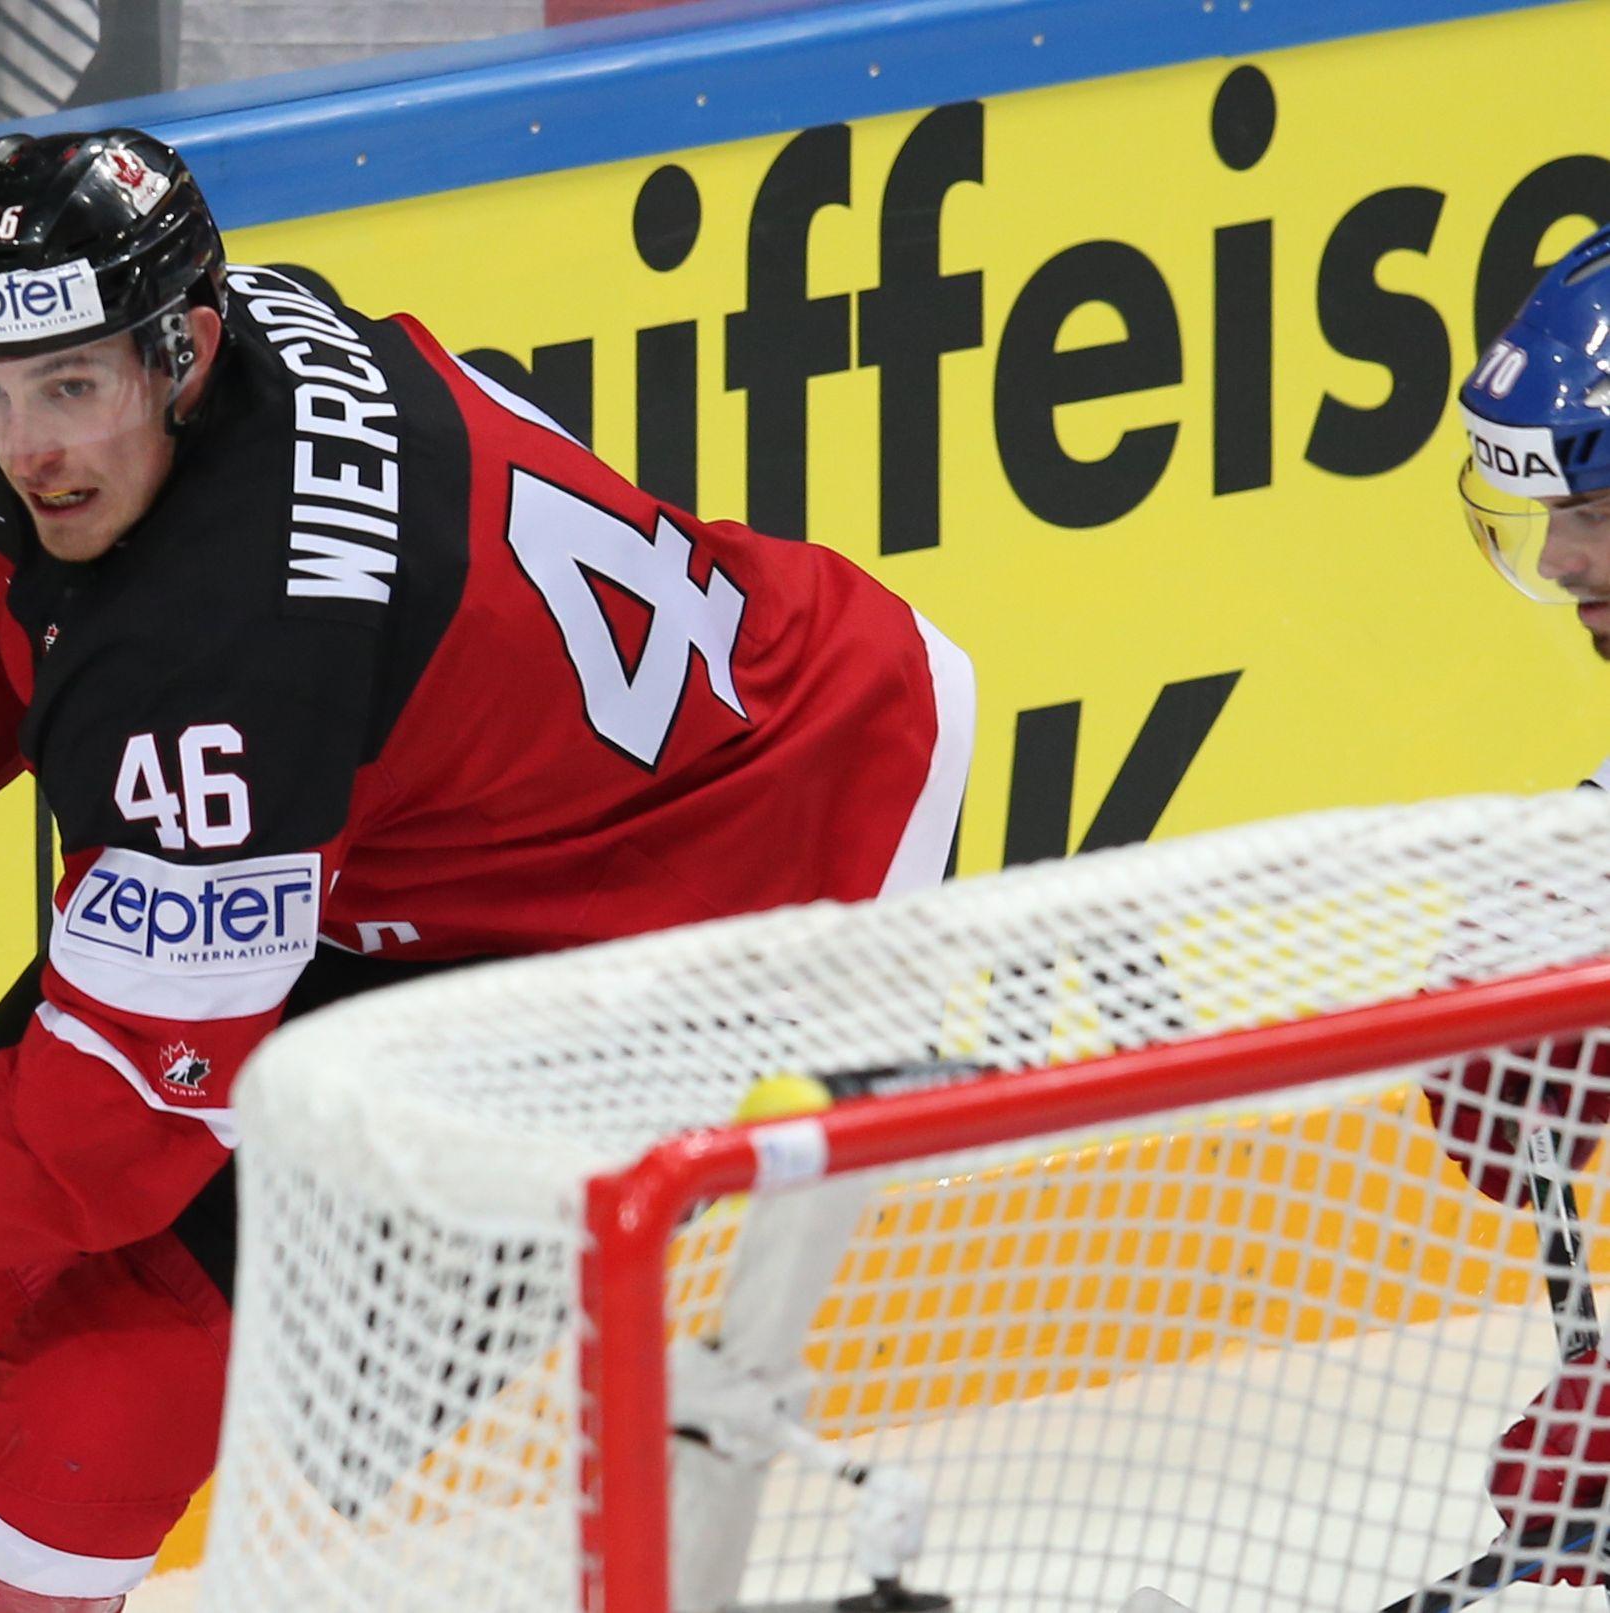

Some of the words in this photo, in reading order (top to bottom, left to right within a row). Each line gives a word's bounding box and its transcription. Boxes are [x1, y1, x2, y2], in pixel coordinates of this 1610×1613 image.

[1468, 430, 1558, 478] ODA
[114, 723, 251, 851] 46
[81, 868, 312, 958] zepter
[169, 939, 309, 963] INTERNATIONAL
